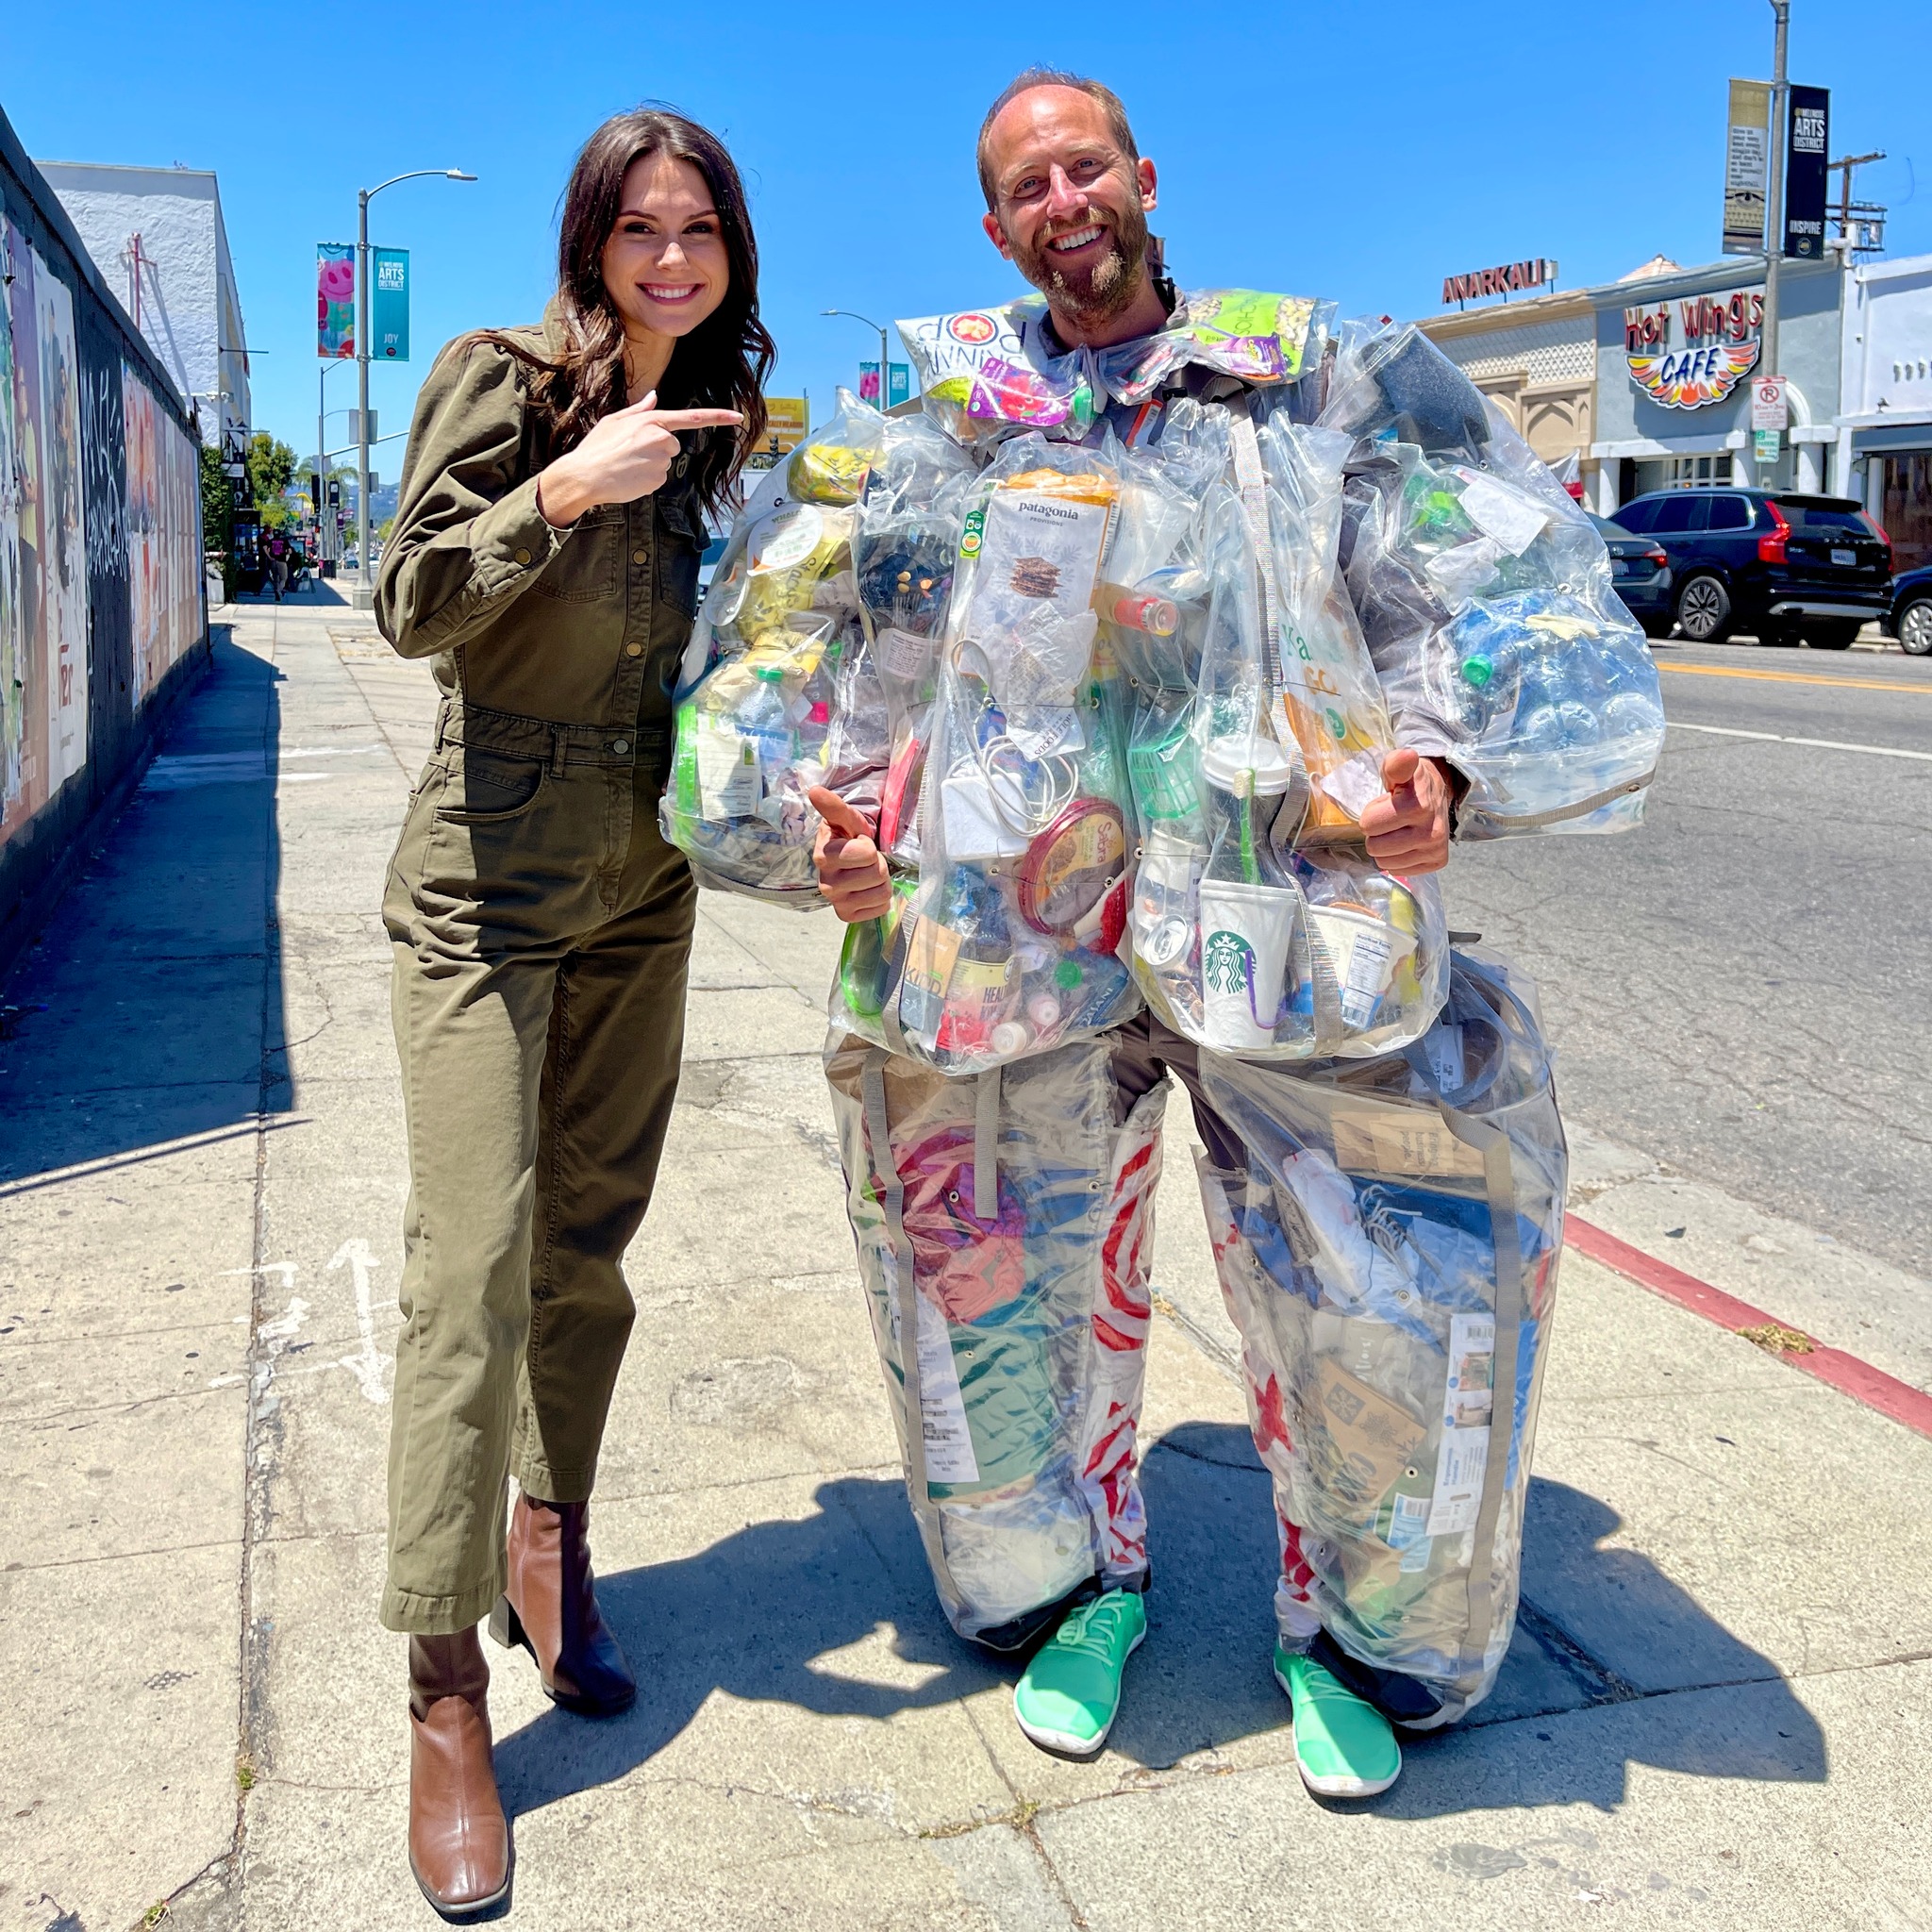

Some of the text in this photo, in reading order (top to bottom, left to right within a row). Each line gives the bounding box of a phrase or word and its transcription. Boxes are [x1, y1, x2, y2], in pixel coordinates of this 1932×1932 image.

[1793, 118, 1824, 137] ARTS
[1793, 137, 1824, 149] DISTRICT
[1790, 220, 1822, 235] INSPIRE
[378, 268, 404, 280] ARTS
[1442, 258, 1545, 305] ANARKALI
[378, 280, 404, 289] DISTRICT
[1624, 291, 1766, 351] Hot Wings
[384, 334, 399, 344] JOY
[1661, 347, 1721, 385] CAFE
[1019, 500, 1078, 521] patagonia
[1030, 516, 1063, 527] PROVISIONS
[1035, 731, 1058, 756] FOODS
[1097, 822, 1112, 865] Sabra
